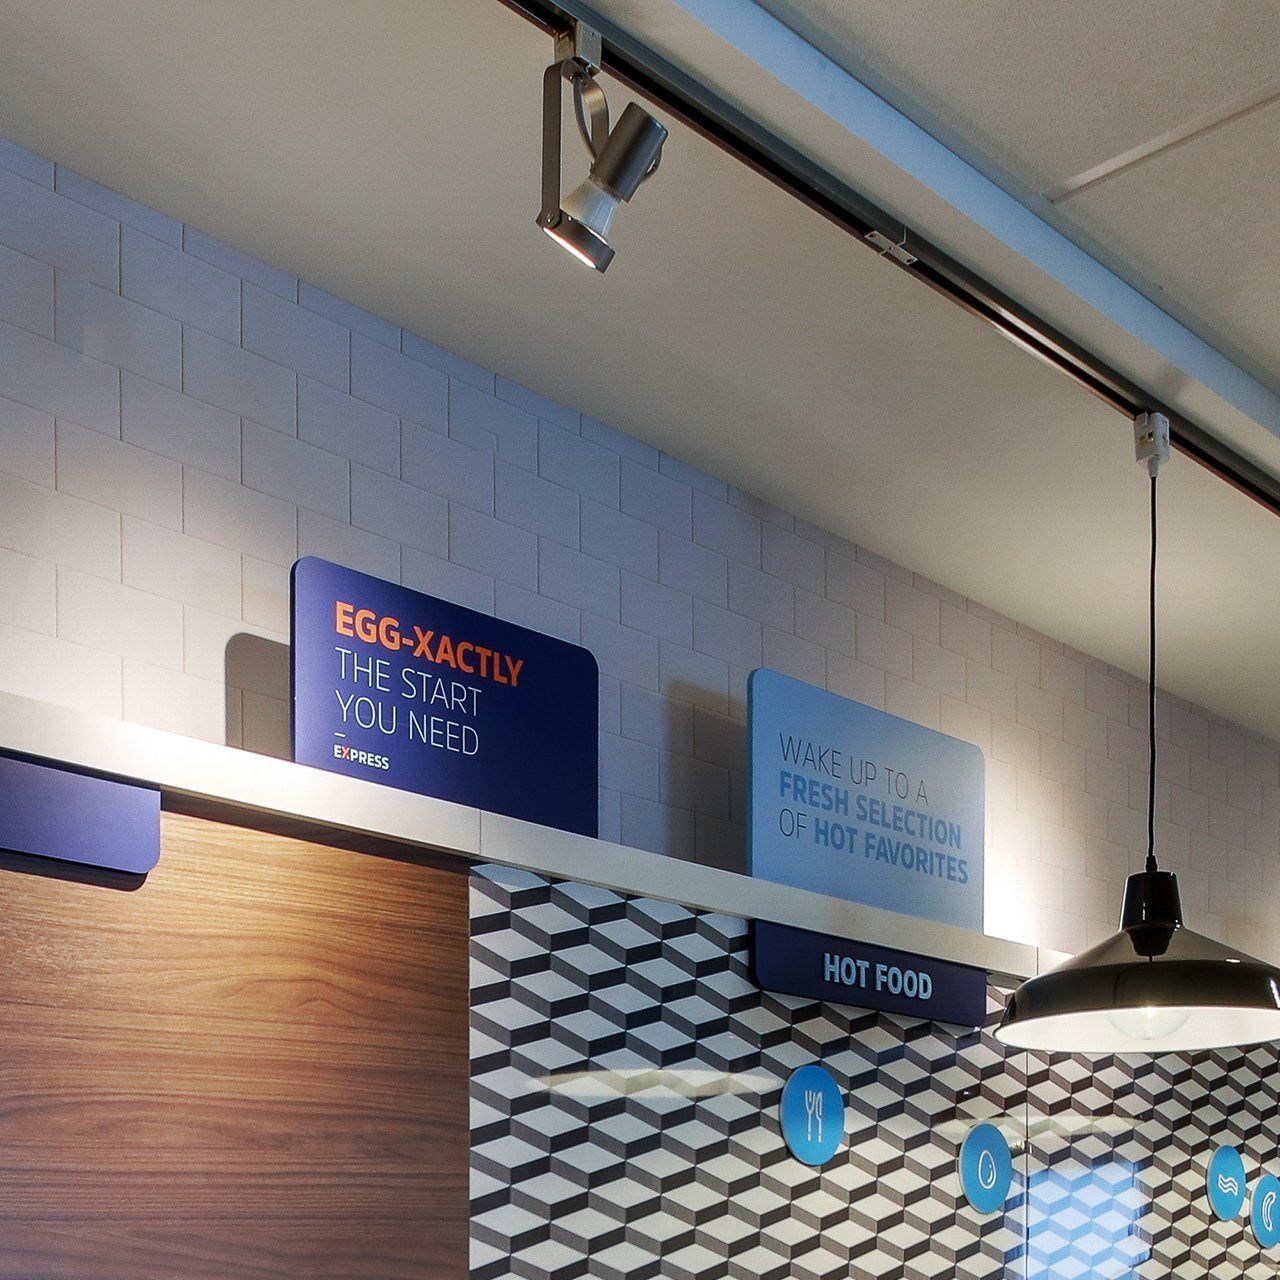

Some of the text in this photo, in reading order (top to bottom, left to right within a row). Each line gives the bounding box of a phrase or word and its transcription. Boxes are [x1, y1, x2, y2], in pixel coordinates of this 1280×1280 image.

[334, 600, 524, 688] EGG-XACTLY
[334, 647, 482, 716] THE START
[333, 744, 390, 770] EXPRESS
[334, 689, 479, 756] YOU NEED
[779, 732, 929, 806] WAKE UP TO A
[779, 769, 962, 850] FRESH SELECTION
[779, 808, 969, 885] OF HOT FAVORITES
[823, 952, 933, 1000] HOT FOOD
